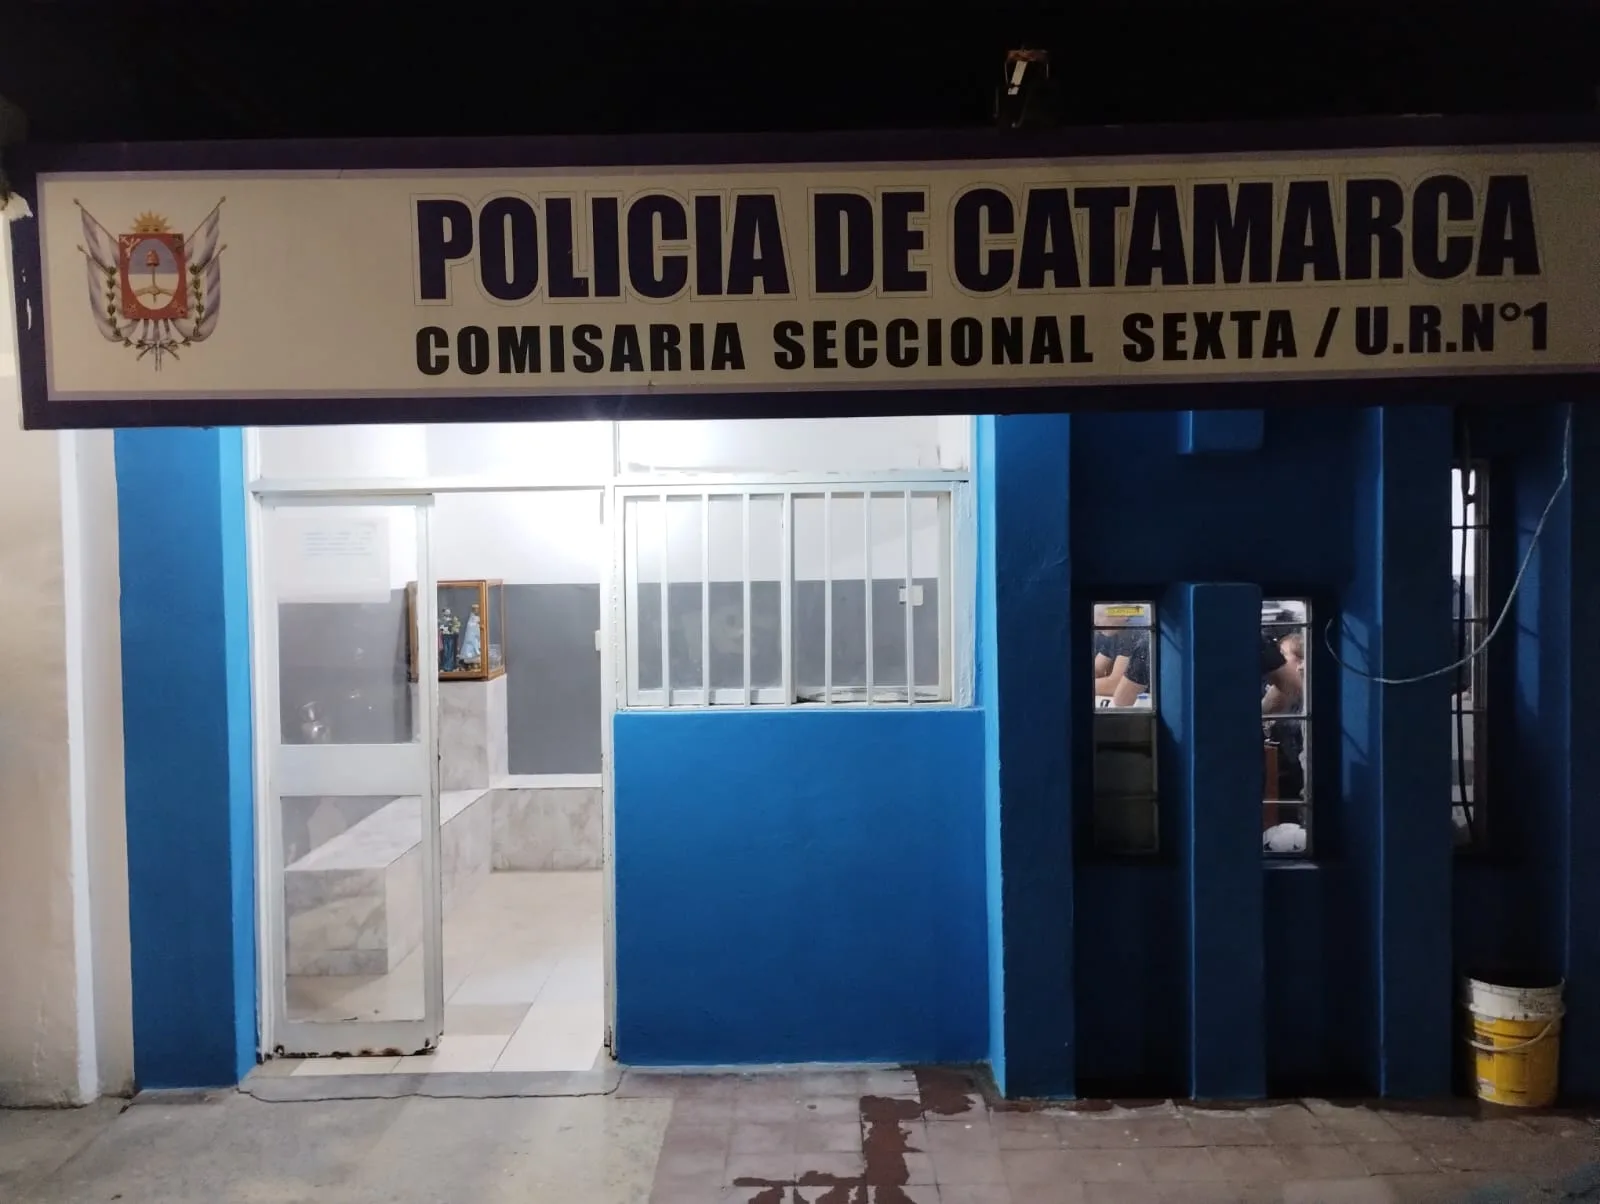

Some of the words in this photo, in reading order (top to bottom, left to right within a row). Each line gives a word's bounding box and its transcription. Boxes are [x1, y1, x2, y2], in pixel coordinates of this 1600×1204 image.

[416, 194, 790, 300] POLICIA
[813, 191, 928, 294] DE
[953, 175, 1542, 293] CATAMARCA
[415, 322, 746, 376] COMISARIA
[772, 314, 1094, 371] SECCIONAL
[1122, 309, 1298, 363] SEXTA
[1313, 306, 1341, 358] /
